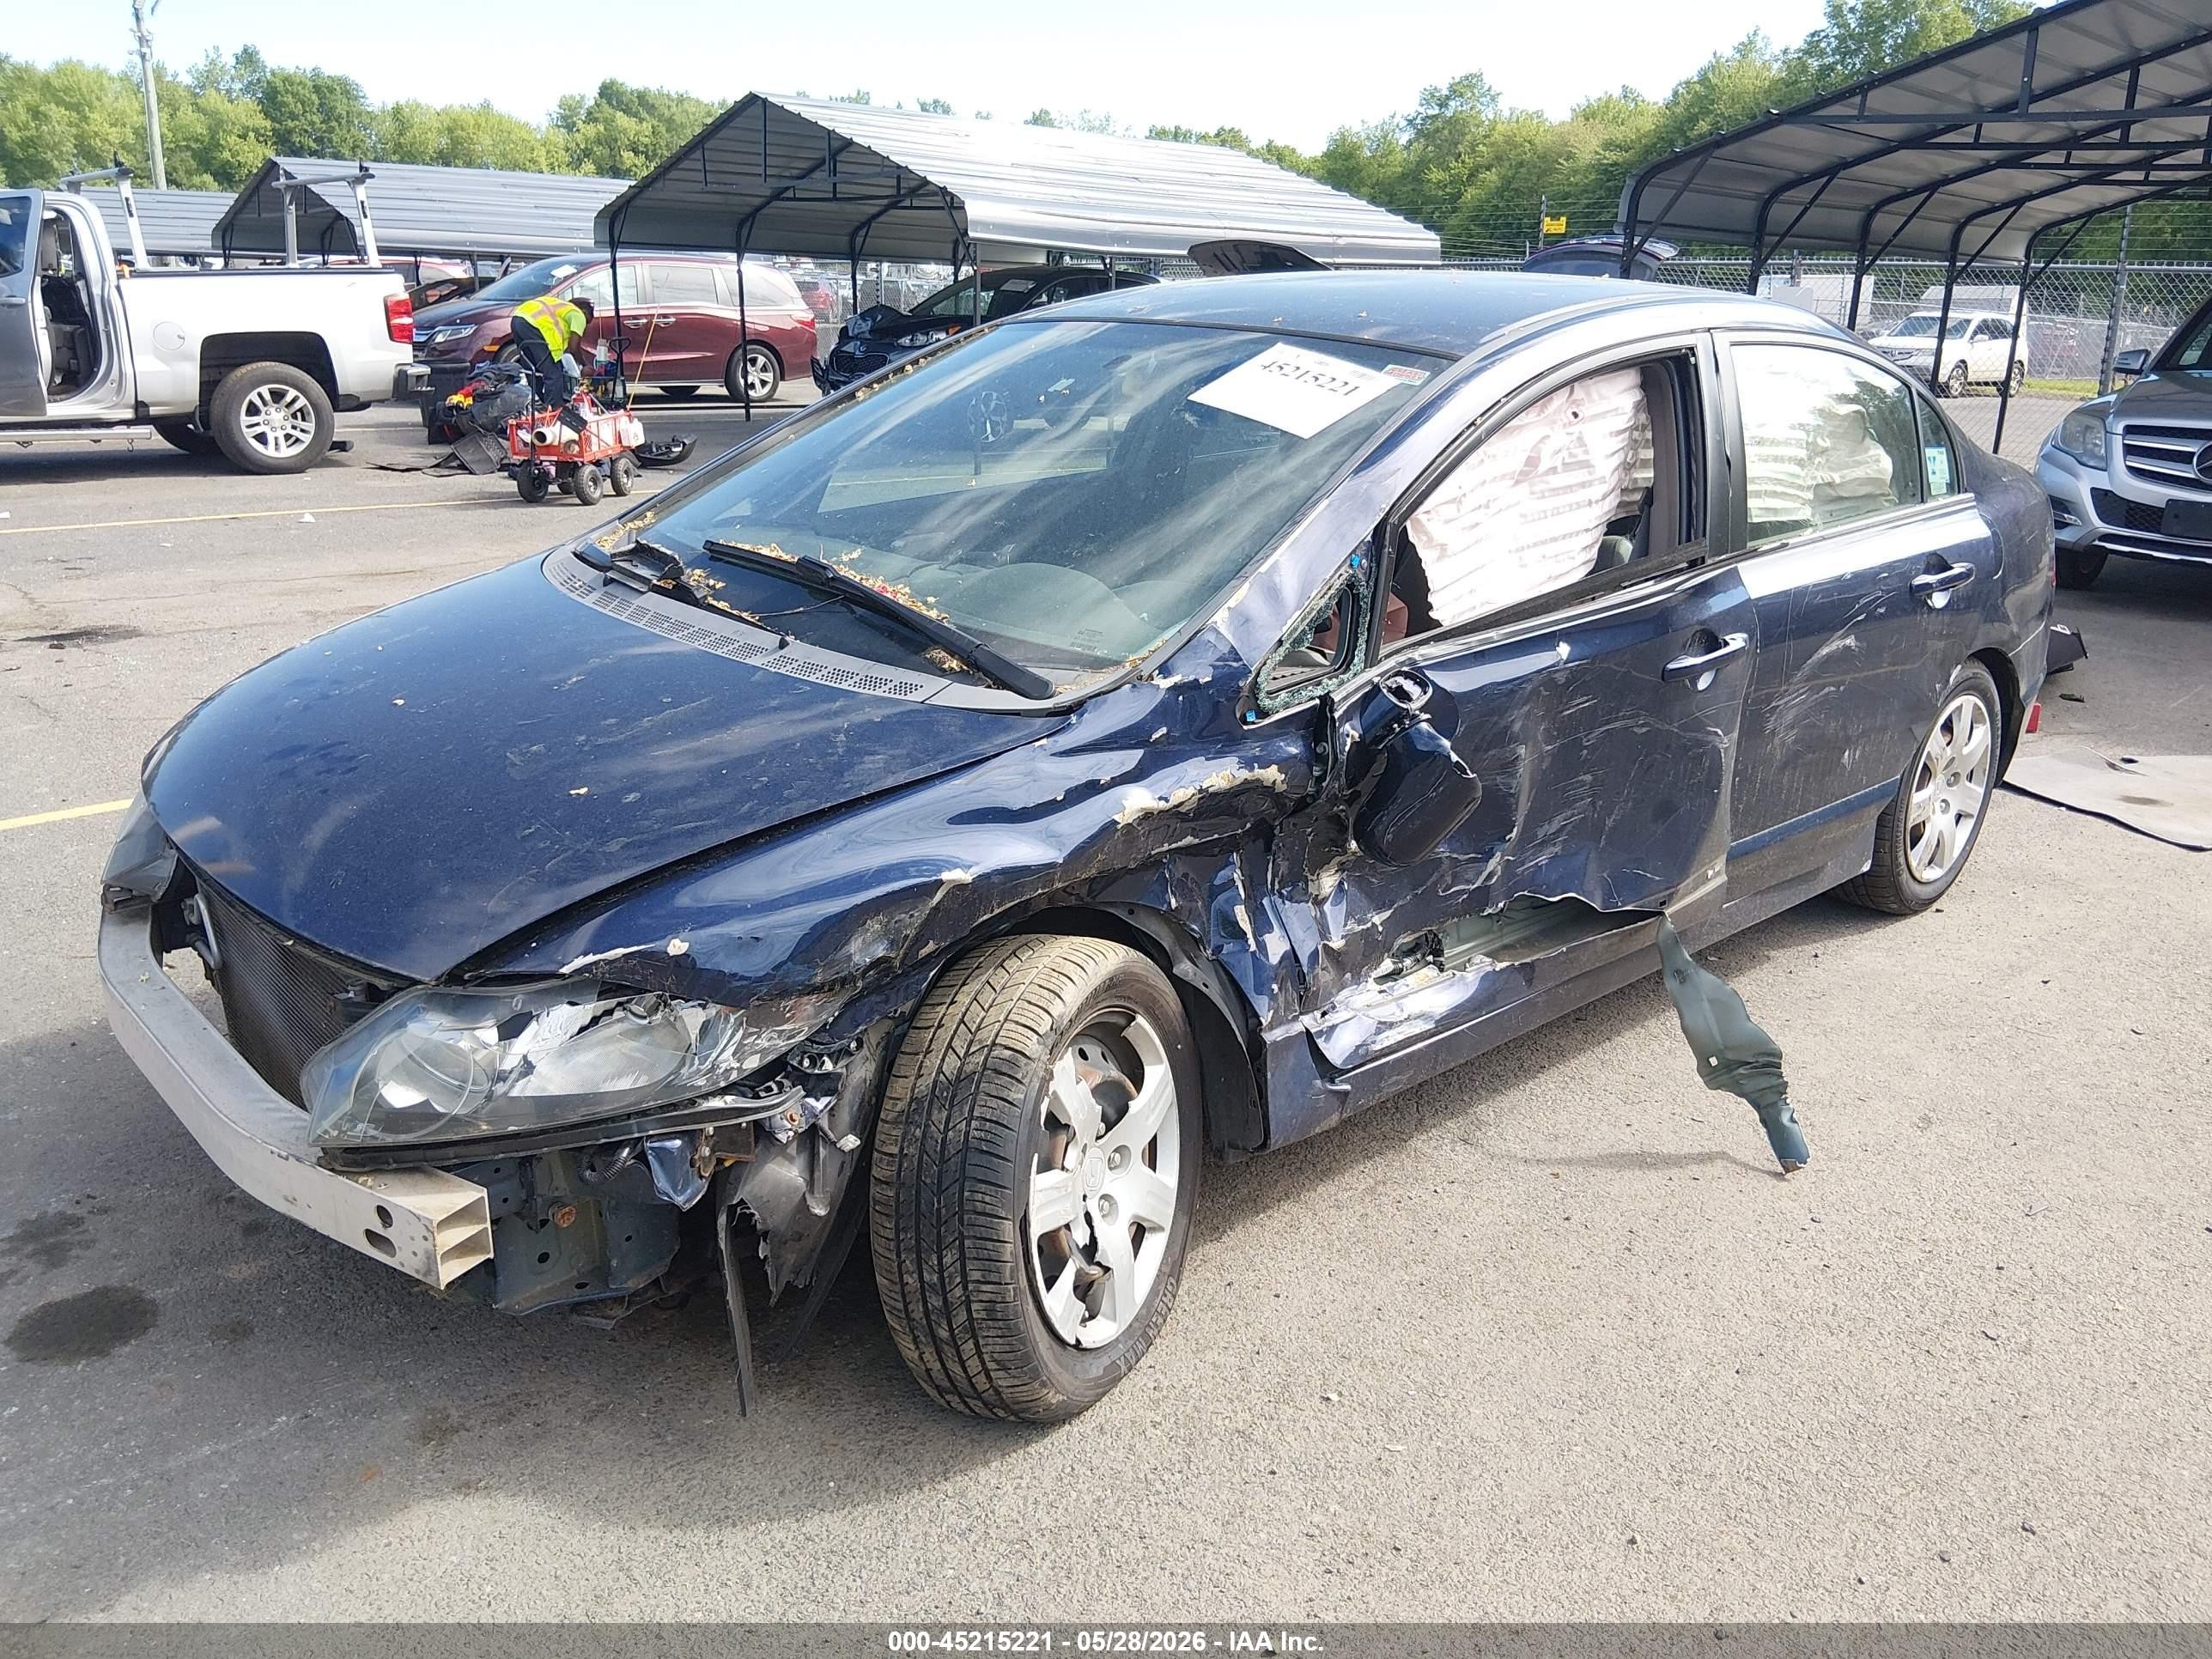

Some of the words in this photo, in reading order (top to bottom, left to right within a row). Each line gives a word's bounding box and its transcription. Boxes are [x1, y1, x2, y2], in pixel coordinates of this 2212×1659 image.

[1261, 361, 1361, 397] 45215221
[1145, 1275, 1177, 1341] GREEN
[1115, 1339, 1148, 1375] MAX
